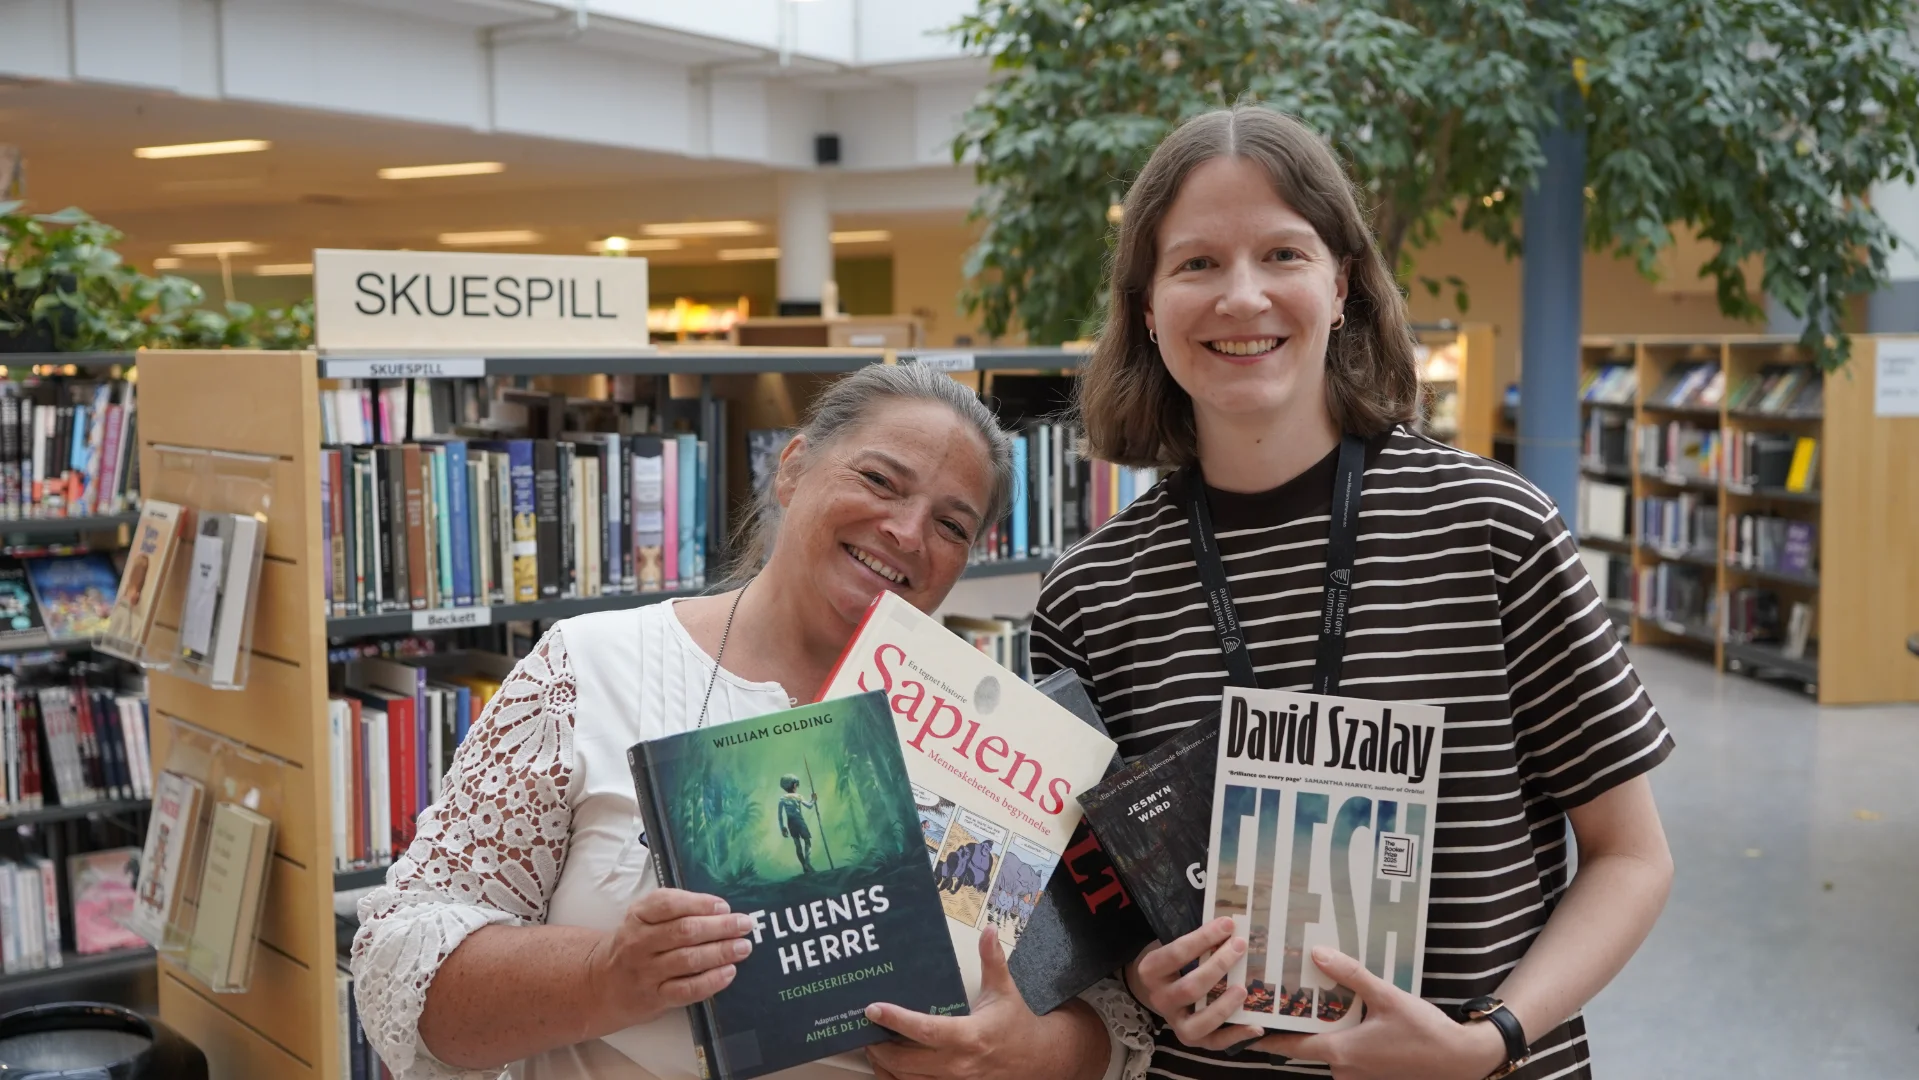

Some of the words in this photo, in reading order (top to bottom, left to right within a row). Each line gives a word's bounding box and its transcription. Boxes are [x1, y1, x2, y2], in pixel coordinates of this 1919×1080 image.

[355, 272, 618, 319] SKUESPILL
[370, 363, 443, 375] SKUESPILL
[428, 613, 476, 626] Beckett
[1210, 590, 1228, 635] Lillestrøm
[1220, 587, 1237, 632] kommune
[1323, 587, 1337, 634] kommune
[1334, 589, 1348, 636] Lillestrøm
[908, 660, 920, 670] En
[918, 667, 941, 686] tegnet
[940, 681, 968, 704] historie
[713, 728, 769, 748] WILLIAM
[773, 714, 833, 735] GOLDING
[857, 643, 1072, 815] Sapiens
[1227, 696, 1319, 766] David
[1324, 705, 1435, 784] Szalay
[928, 749, 1001, 803] Menneskehetens
[1001, 796, 1051, 836] begynnelse
[1117, 778, 1134, 790] USAs
[1134, 770, 1149, 781] beste
[1126, 785, 1172, 816] JESMYN
[1267, 774, 1284, 782] every
[1304, 777, 1343, 787] SAMANTHA
[1344, 781, 1373, 790] HARVEY,
[1138, 800, 1171, 823] WARD
[1062, 815, 1131, 915] LT
[748, 885, 890, 944] FLUENES
[1207, 784, 1427, 1023] FLESH
[778, 923, 880, 975] HERRE
[778, 962, 894, 1001] TEGNESERIEROMAN
[806, 1025, 838, 1042] AIMÉE
[840, 1021, 854, 1033] DE
[857, 1017, 873, 1030] JO
[814, 1013, 839, 1026] Adaptert
